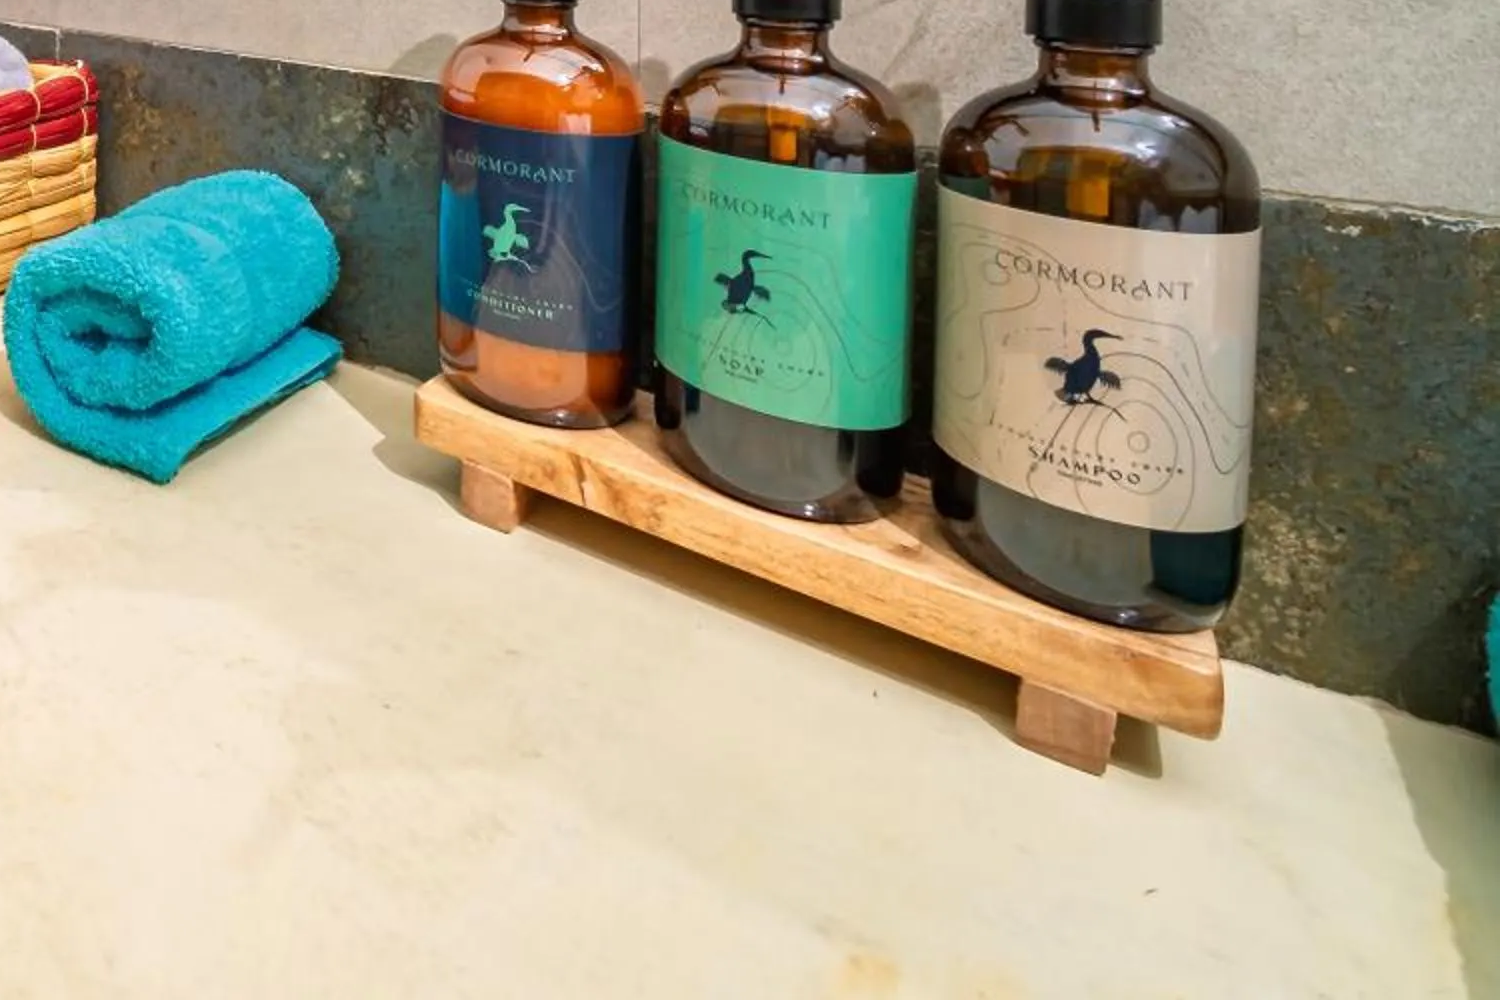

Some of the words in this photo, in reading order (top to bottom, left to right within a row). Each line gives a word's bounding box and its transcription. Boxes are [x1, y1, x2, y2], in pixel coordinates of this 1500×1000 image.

[455, 148, 576, 183] CORMORANT
[681, 181, 831, 229] CORMORANT
[995, 250, 1194, 301] CORMORANT
[1028, 446, 1141, 486] SHAMPOO
